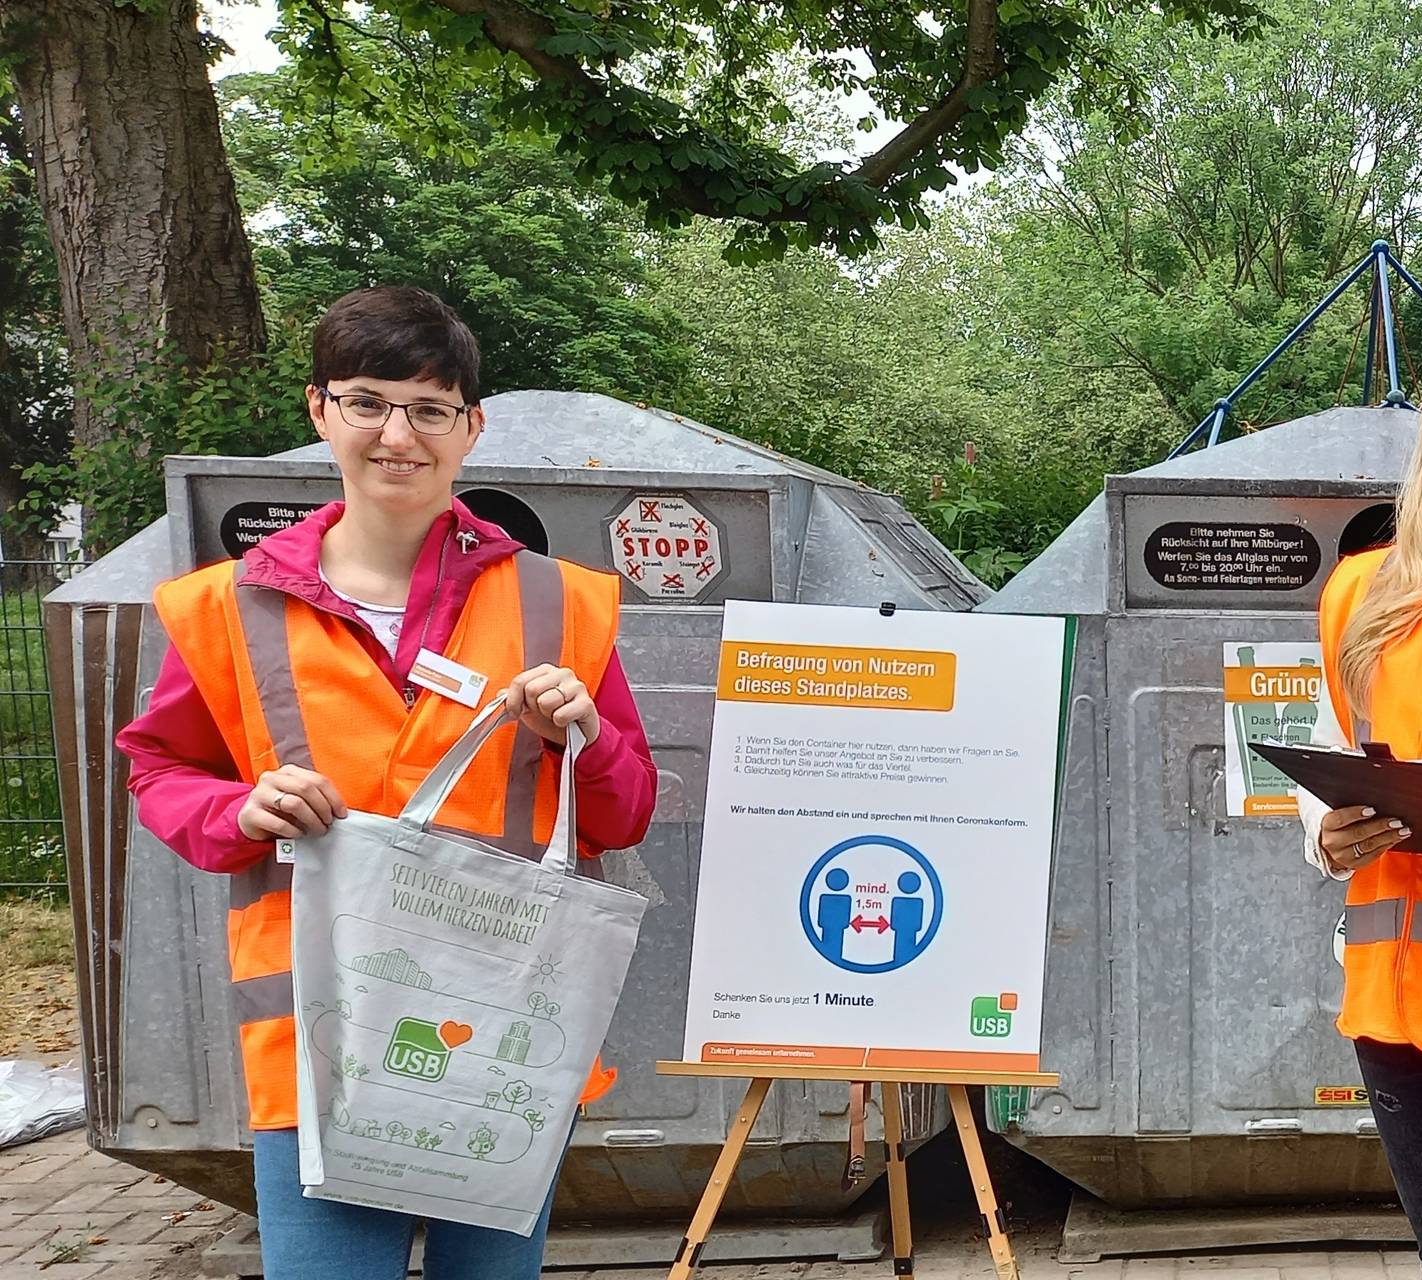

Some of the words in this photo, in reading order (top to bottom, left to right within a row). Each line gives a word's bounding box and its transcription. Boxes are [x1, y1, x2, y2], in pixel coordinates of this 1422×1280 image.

[268, 507, 295, 517] Bitte
[238, 518, 292, 529] Rücksicht
[1190, 527, 1214, 538] Bitte
[1216, 528, 1256, 538] nehmen
[1259, 528, 1275, 538] Sie
[622, 537, 709, 558] STOPP
[1161, 537, 1210, 548] Rücksicht
[1211, 539, 1228, 548] auf
[1230, 539, 1249, 548] Ihre
[1157, 551, 1193, 561] Werfen
[1195, 552, 1211, 561] Sie
[1214, 552, 1232, 562] das
[1235, 552, 1269, 564] Altglas
[1271, 554, 1288, 562] nur
[1290, 554, 1308, 562] von
[1201, 563, 1217, 572] bis
[1245, 563, 1263, 573] Uhr
[1164, 574, 1175, 583] An
[1202, 575, 1218, 583] und
[737, 650, 827, 675] Befragung
[832, 659, 863, 673] von
[868, 657, 935, 677] Nutzern
[734, 676, 792, 695] dieses
[796, 678, 912, 701] Standplatzes.
[1251, 716, 1271, 725] Das
[1274, 715, 1309, 728] gehört
[747, 736, 771, 745] Wenn
[773, 737, 787, 746] Sie
[788, 738, 804, 747] den
[806, 738, 846, 749] Container
[848, 741, 864, 749] hier
[897, 743, 919, 752] dann
[920, 744, 947, 754] haben
[948, 746, 961, 754] wir
[962, 747, 991, 757] Fragen
[745, 746, 771, 755] Damit
[772, 748, 798, 756] helfen
[799, 748, 813, 757] Sie
[814, 750, 838, 758] unser
[839, 750, 875, 760] Angebot
[889, 752, 903, 762] Sie
[744, 756, 780, 765] Dadurch
[782, 757, 797, 766] tun
[797, 757, 812, 767] Sie
[813, 759, 834, 768] auch
[835, 761, 853, 769] was
[855, 760, 866, 769] für
[867, 761, 884, 770] das
[743, 765, 791, 778] Gleichzeitig
[792, 768, 824, 777] können
[825, 768, 839, 778] Sie
[841, 771, 879, 780] attraktive
[880, 772, 905, 782] Preise
[730, 805, 746, 814] Wir
[747, 806, 776, 815] halten
[777, 807, 795, 816] den
[796, 808, 834, 818] Abstand
[835, 810, 850, 819] ein
[852, 811, 869, 820] und
[870, 813, 912, 823] sprechen
[914, 814, 928, 823] mit
[930, 815, 955, 824] Ihnen
[957, 816, 1028, 827] Coronakonform.
[391, 863, 419, 887] SEIT
[421, 872, 469, 902] VIELEN
[468, 888, 519, 916] JAHREN
[520, 900, 550, 924] MIT
[856, 883, 889, 894] mind.
[856, 899, 882, 909] 1,5m
[392, 888, 443, 922] VOLLEM
[444, 906, 492, 934] HERZEN
[492, 919, 538, 946] DABEI!
[713, 992, 757, 1002] Schenken
[759, 993, 772, 1003] Sie
[774, 996, 790, 1004] uns
[791, 995, 810, 1005] jetzt
[813, 993, 820, 1004] 1
[712, 1010, 741, 1019] Danke
[973, 1017, 1008, 1034] USB
[389, 1046, 441, 1077] USB
